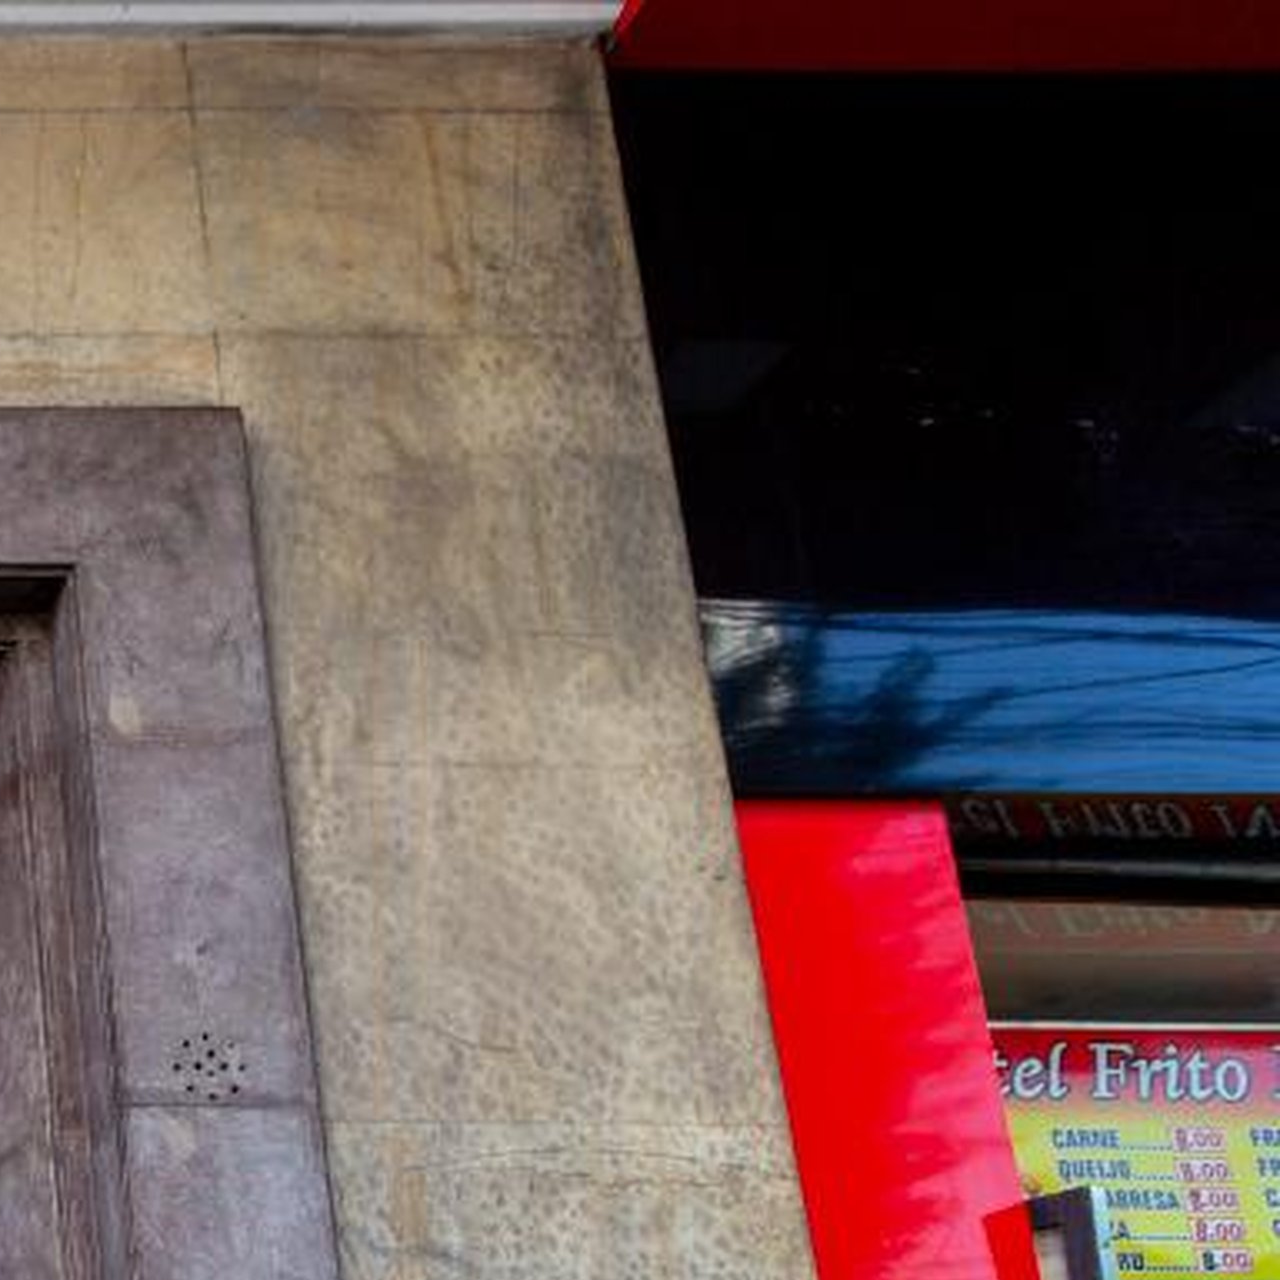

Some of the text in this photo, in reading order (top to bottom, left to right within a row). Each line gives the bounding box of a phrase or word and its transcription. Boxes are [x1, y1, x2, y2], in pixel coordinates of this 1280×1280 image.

[1088, 1041, 1249, 1101] Frito
[1051, 1129, 1121, 1149] CARNE
[1058, 1159, 1132, 1182] QUEIJO
